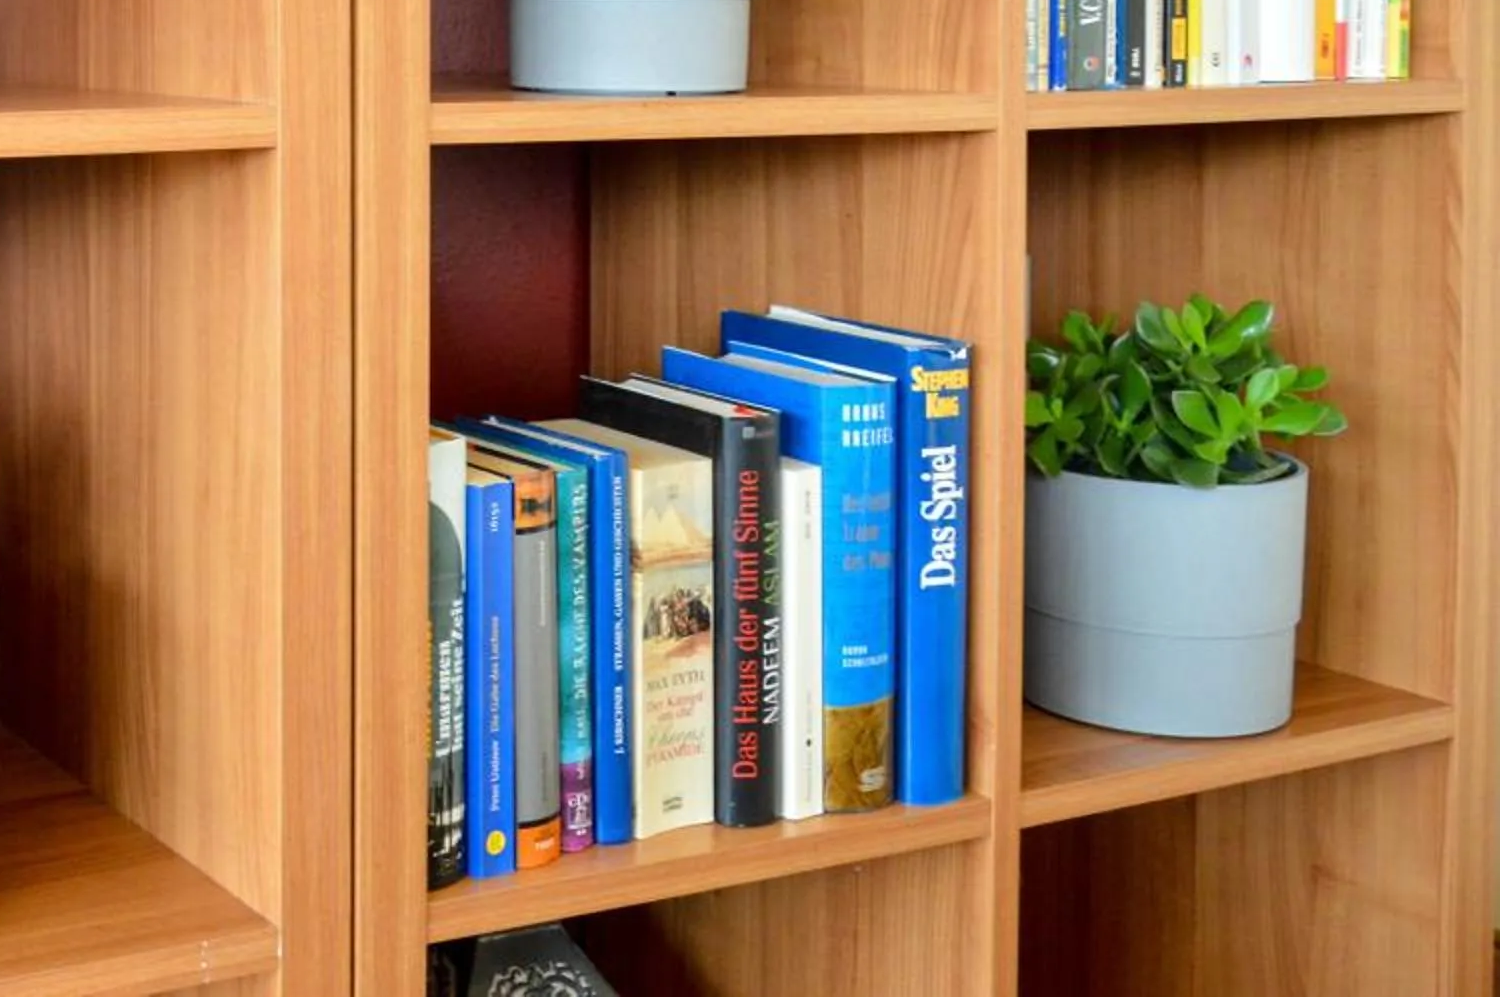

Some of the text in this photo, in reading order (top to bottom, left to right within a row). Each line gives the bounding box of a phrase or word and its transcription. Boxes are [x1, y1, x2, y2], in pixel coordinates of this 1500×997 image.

[924, 391, 960, 419] KING
[610, 479, 622, 553] GESCHICHTEN
[918, 444, 964, 591] Das Spiel
[612, 554, 623, 578] UND
[573, 573, 587, 606] DES
[612, 580, 623, 619] GASSEN
[573, 607, 587, 669] RACHE
[731, 469, 758, 779] Das Haus der fünf Sinne
[762, 520, 781, 724] NADEEM ASLAM
[573, 674, 587, 700] DIE
[489, 740, 500, 782] Ustinov
[489, 783, 500, 812] Peter
